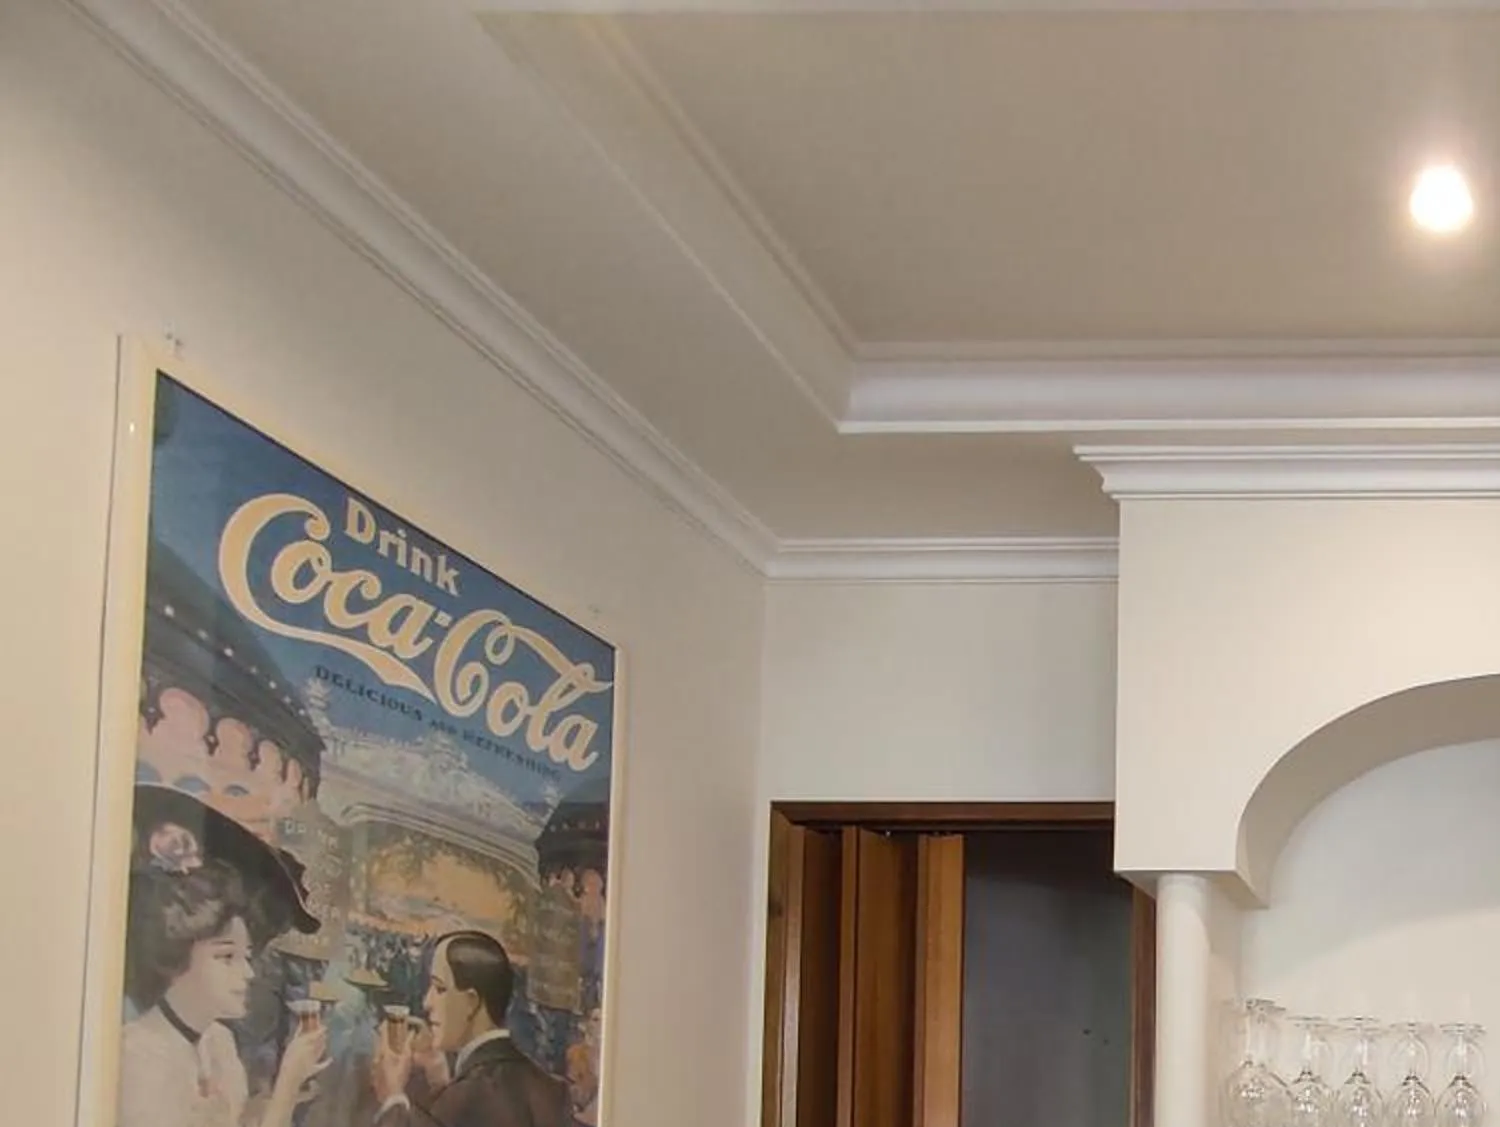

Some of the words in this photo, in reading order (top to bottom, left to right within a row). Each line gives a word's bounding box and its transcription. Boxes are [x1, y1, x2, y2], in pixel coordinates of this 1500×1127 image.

[344, 496, 461, 597] Drink
[218, 492, 613, 771] Coca-Cola
[314, 664, 424, 723] DELICIOUS
